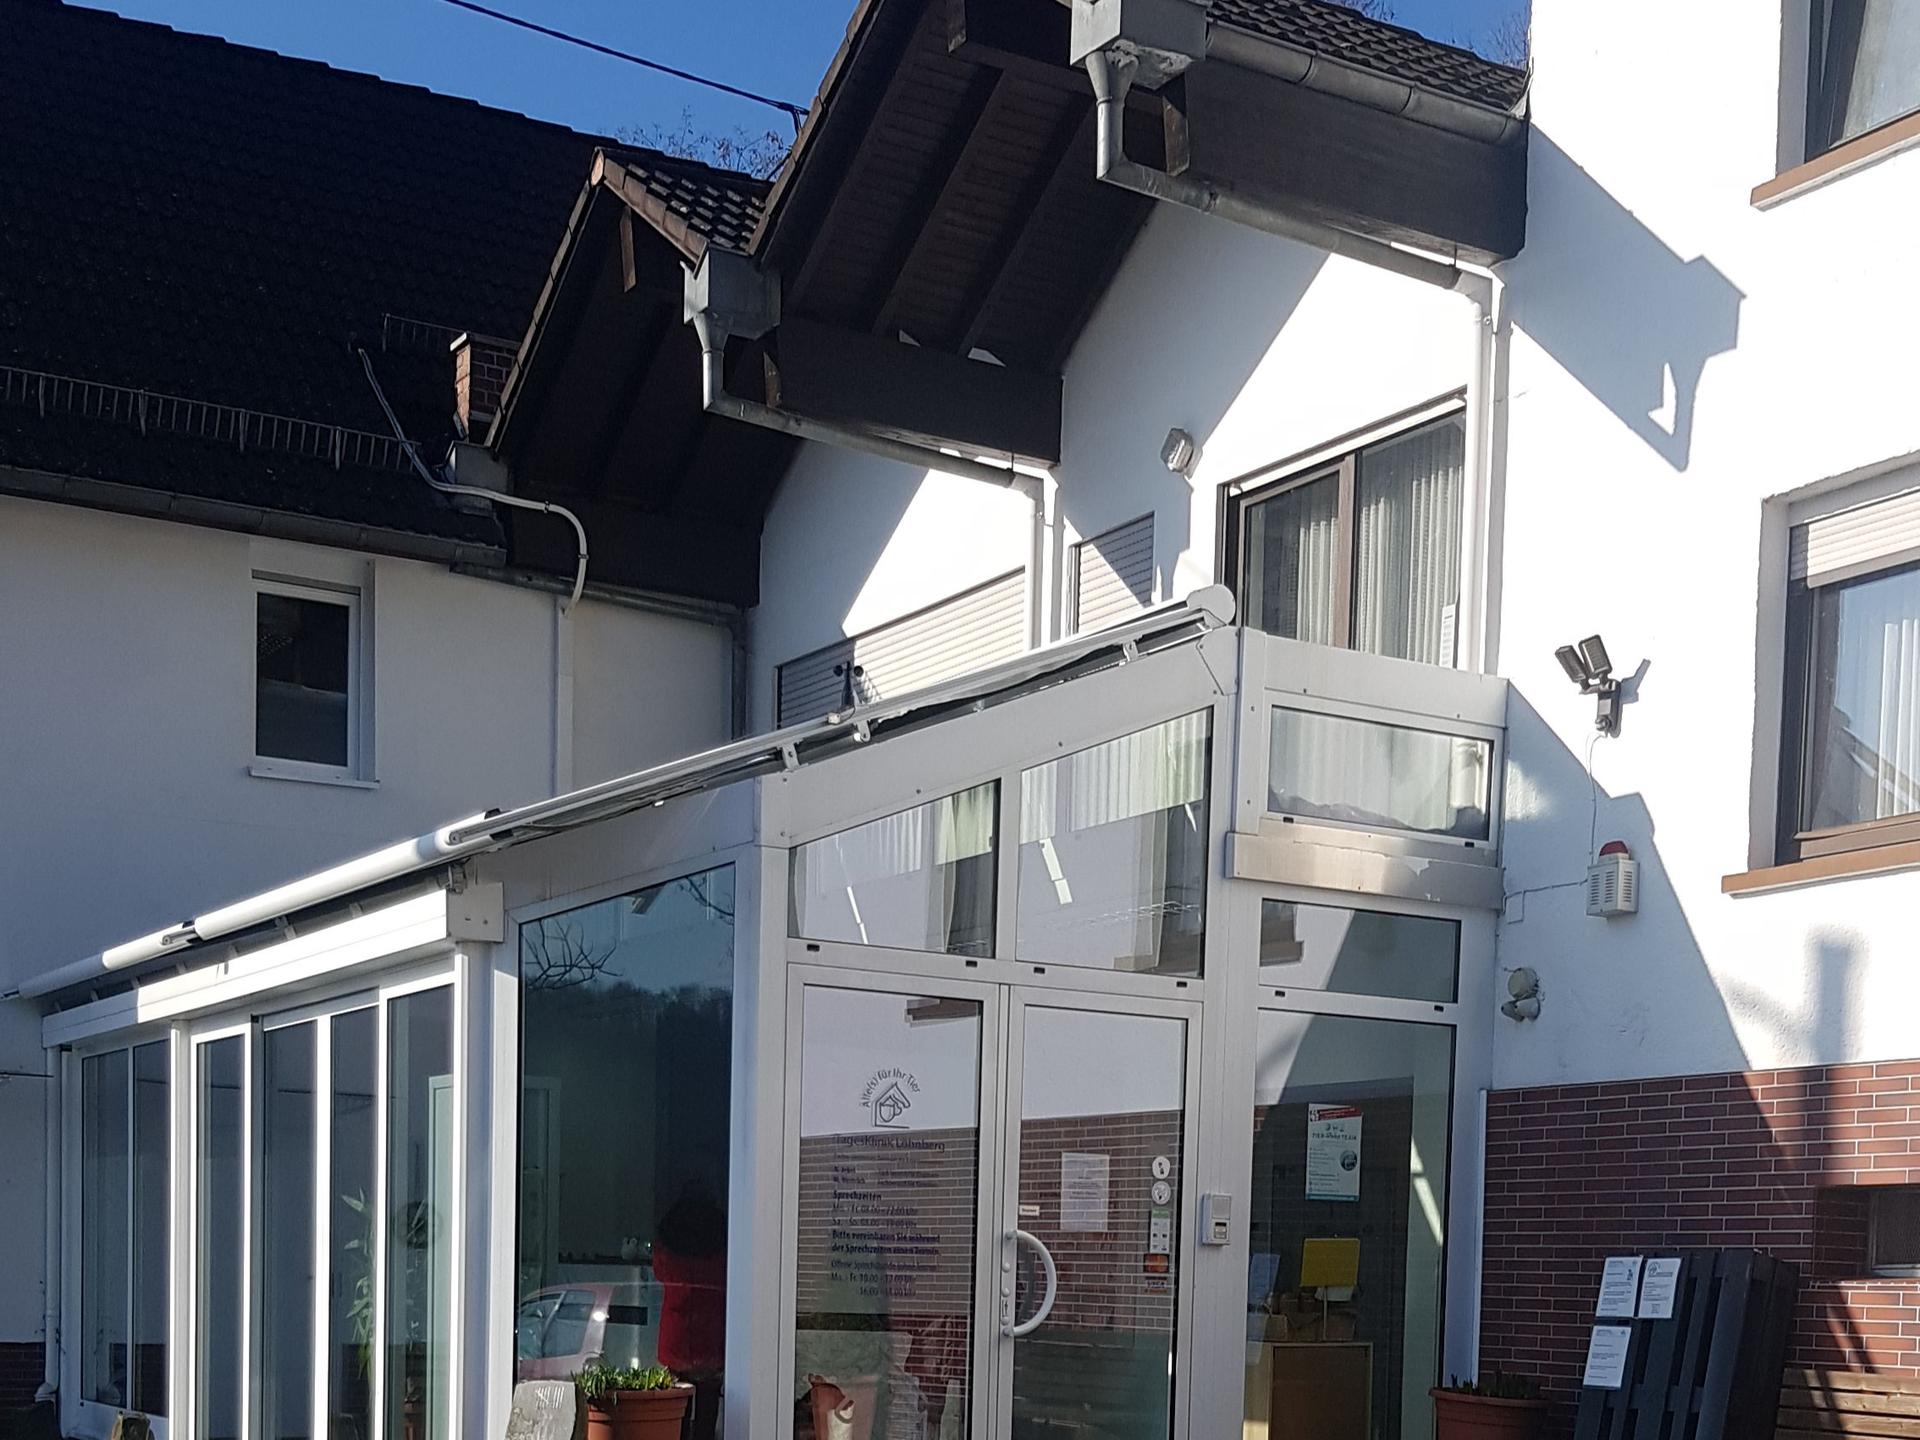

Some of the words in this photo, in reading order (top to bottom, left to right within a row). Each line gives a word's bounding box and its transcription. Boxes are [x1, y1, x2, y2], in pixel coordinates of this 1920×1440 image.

[893, 1067, 907, 1079] Ihr
[906, 1073, 921, 1092] Tier
[832, 1190, 882, 1201] Sprechzeiten
